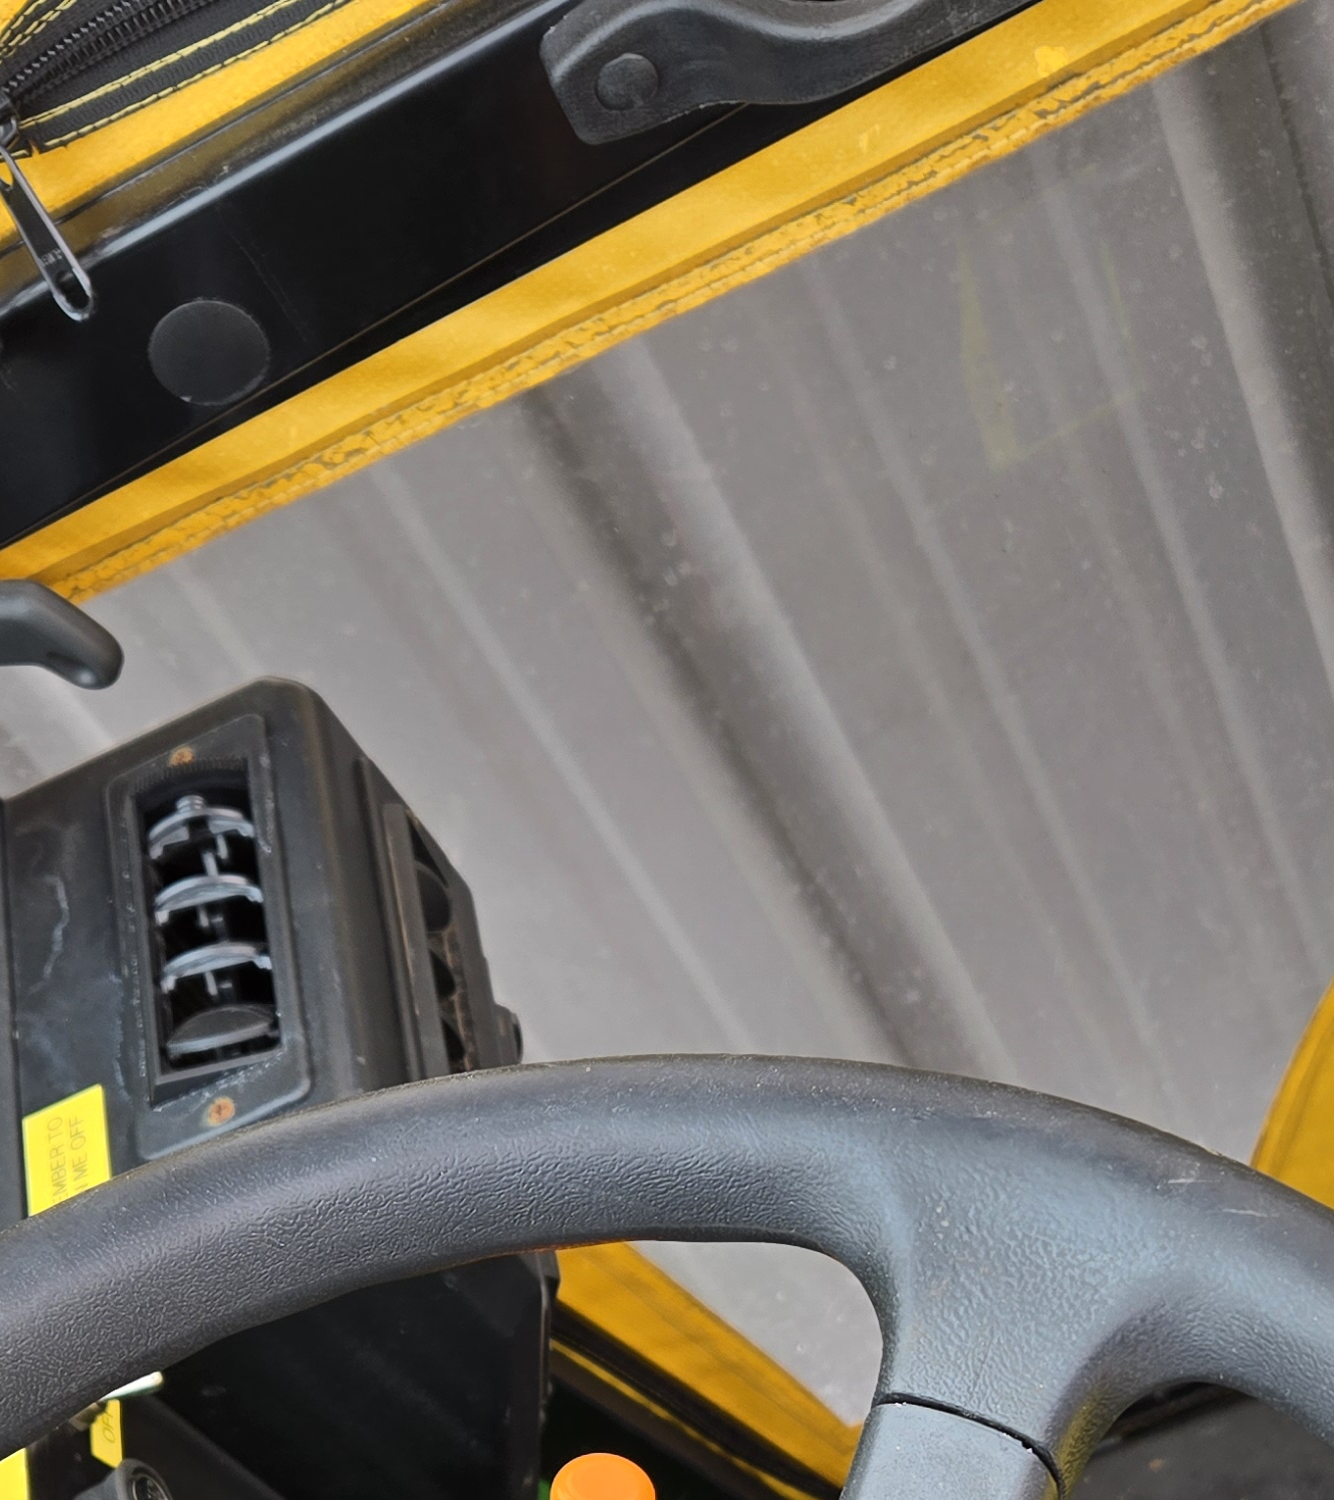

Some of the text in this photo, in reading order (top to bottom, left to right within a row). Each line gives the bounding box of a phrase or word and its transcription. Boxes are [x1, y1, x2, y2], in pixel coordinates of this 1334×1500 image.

[67, 1115, 87, 1150] OFF
[45, 1116, 70, 1202] EMBER TO
[71, 1151, 90, 1179] ME
